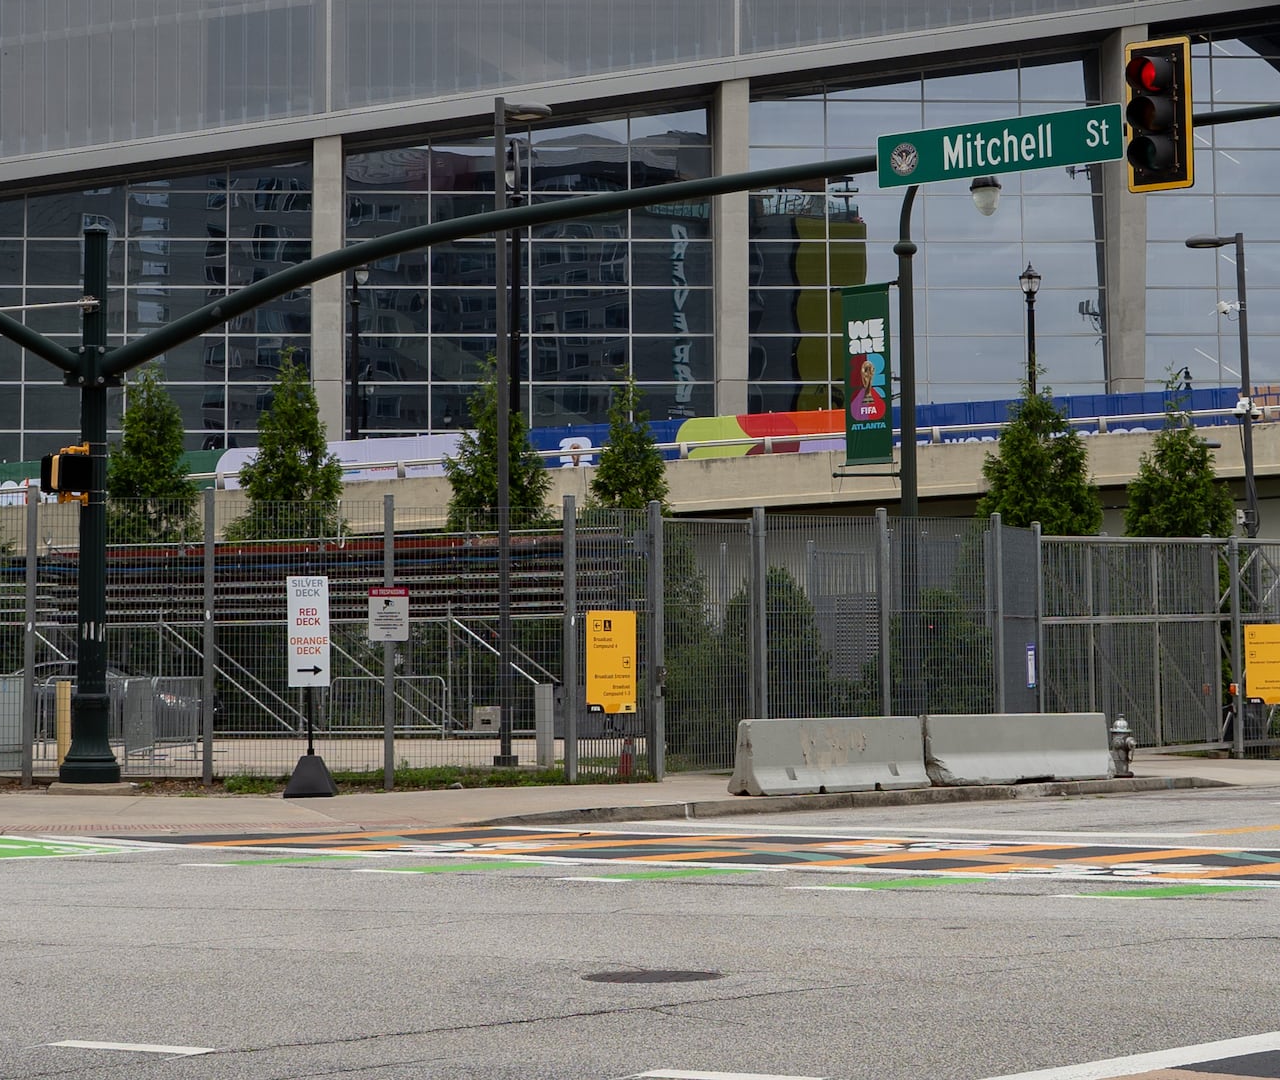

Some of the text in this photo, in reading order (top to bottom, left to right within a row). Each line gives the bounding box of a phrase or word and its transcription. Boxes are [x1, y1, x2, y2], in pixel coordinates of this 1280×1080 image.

[943, 119, 1109, 170] Mitchell St
[848, 318, 884, 340] WE
[860, 406, 878, 415] FIFA
[851, 422, 887, 431] ATLANTA
[291, 579, 324, 588] SILVER
[296, 588, 320, 597] DECK
[299, 607, 318, 616] RED
[296, 618, 321, 626] DECK
[289, 636, 328, 646] ORANGE
[296, 646, 322, 655] DECK
